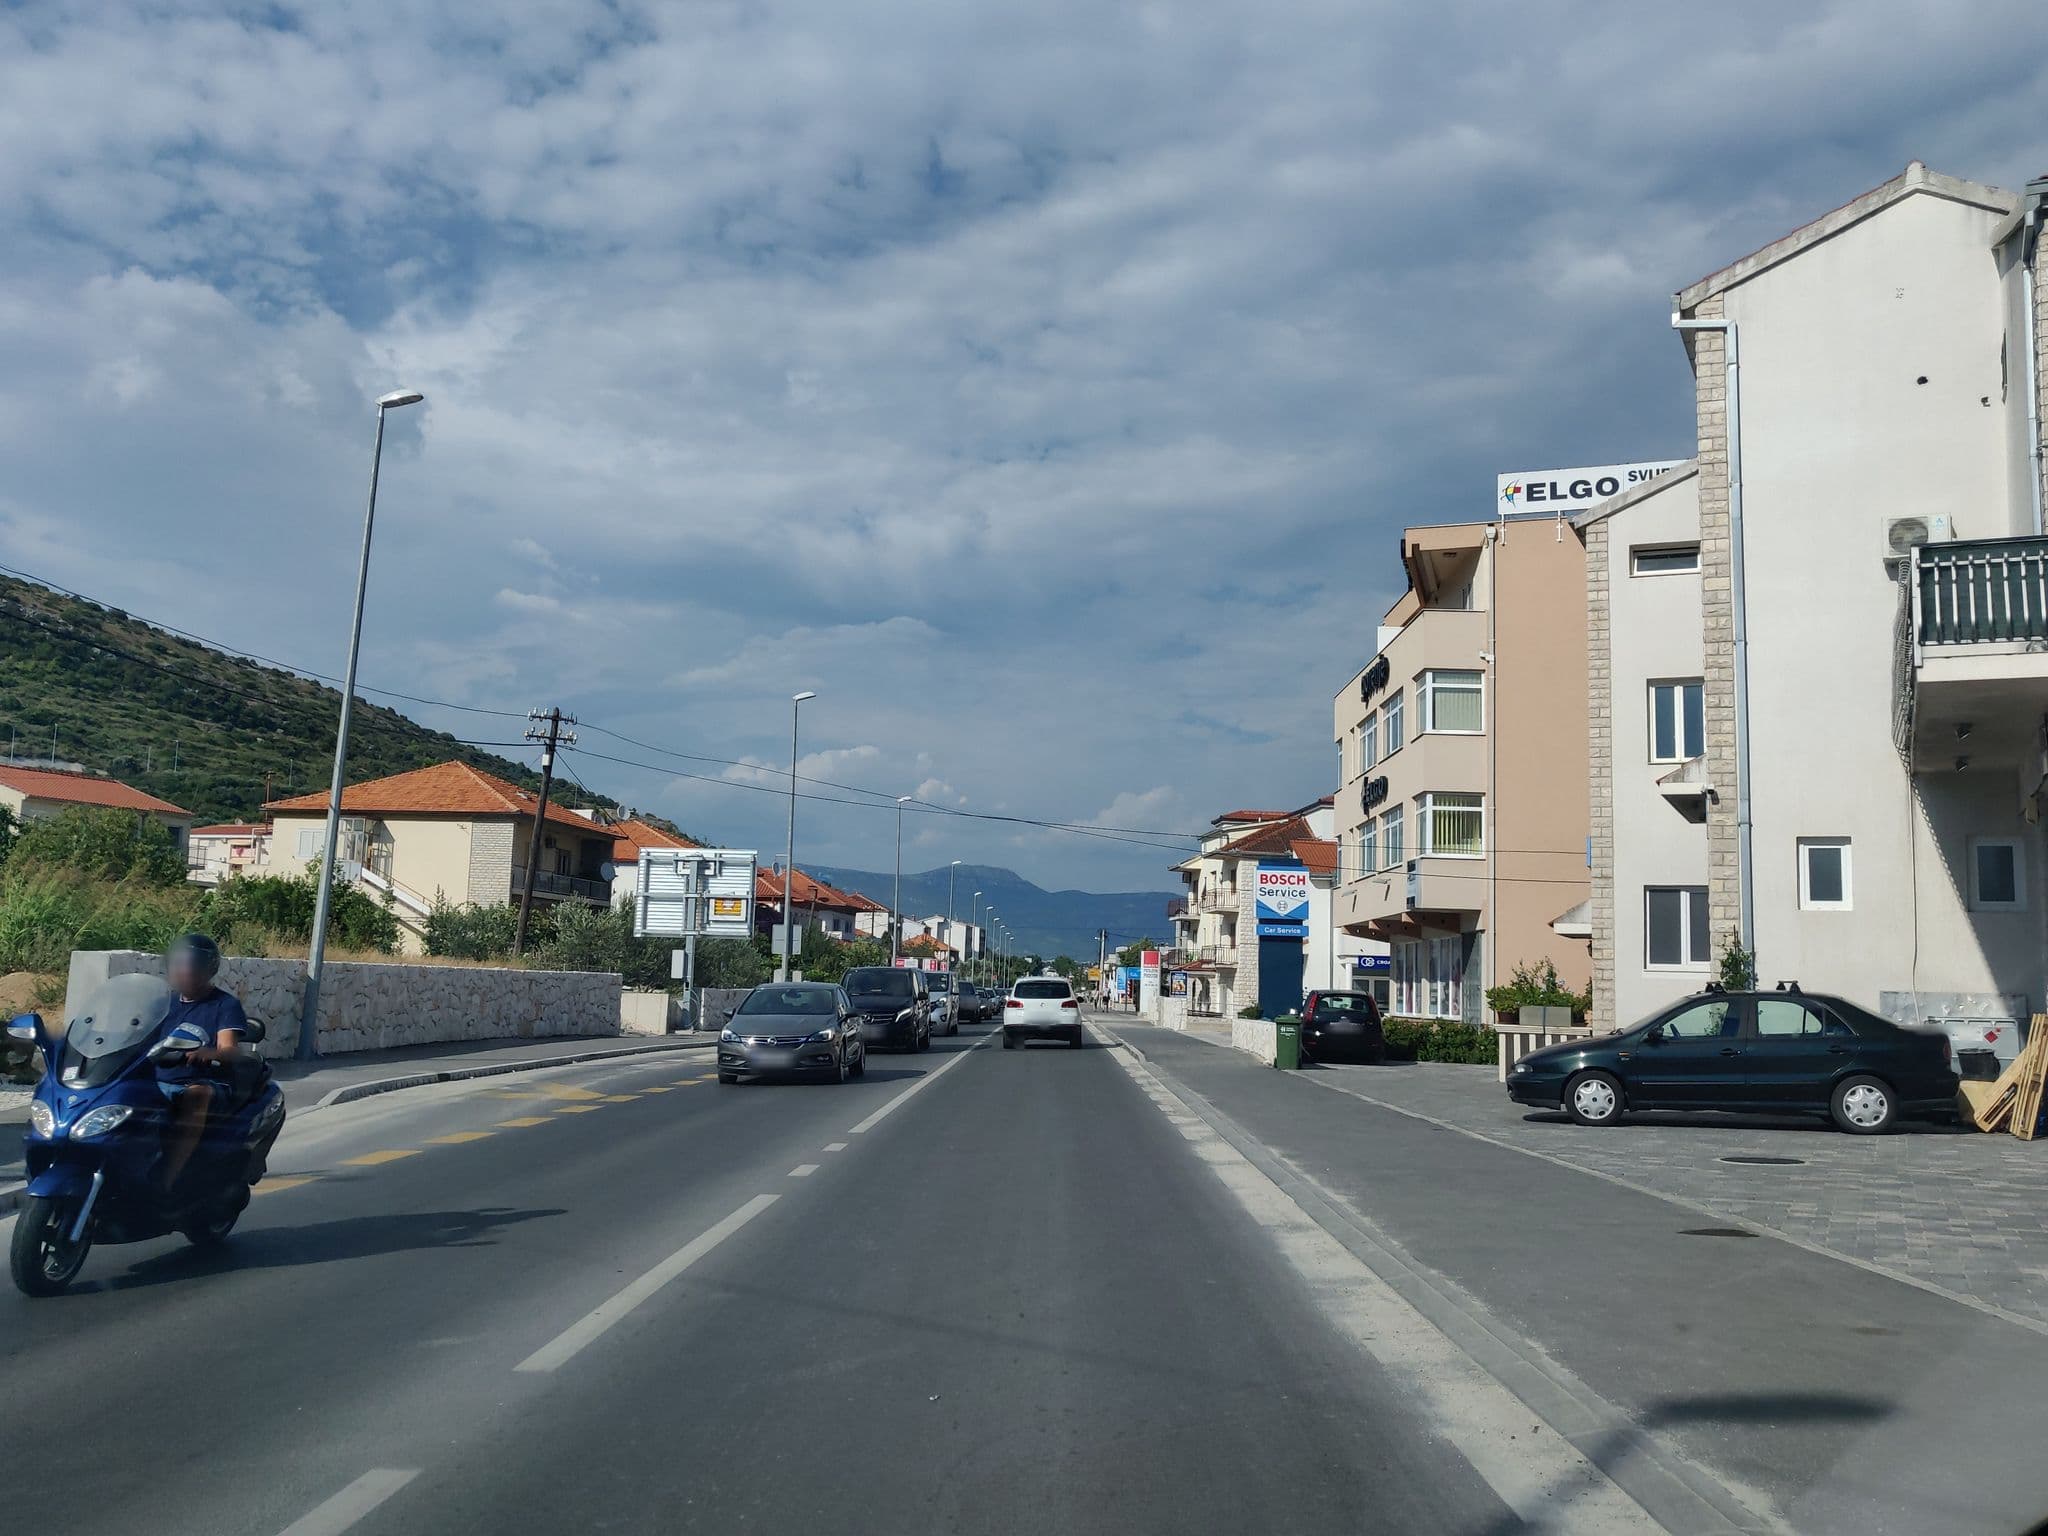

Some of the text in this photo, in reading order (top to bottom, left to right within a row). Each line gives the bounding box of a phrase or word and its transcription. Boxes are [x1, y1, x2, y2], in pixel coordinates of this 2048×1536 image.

[1526, 477, 1620, 502] ELGO
[1260, 874, 1306, 886] BOSCH
[1259, 887, 1306, 898] Service
